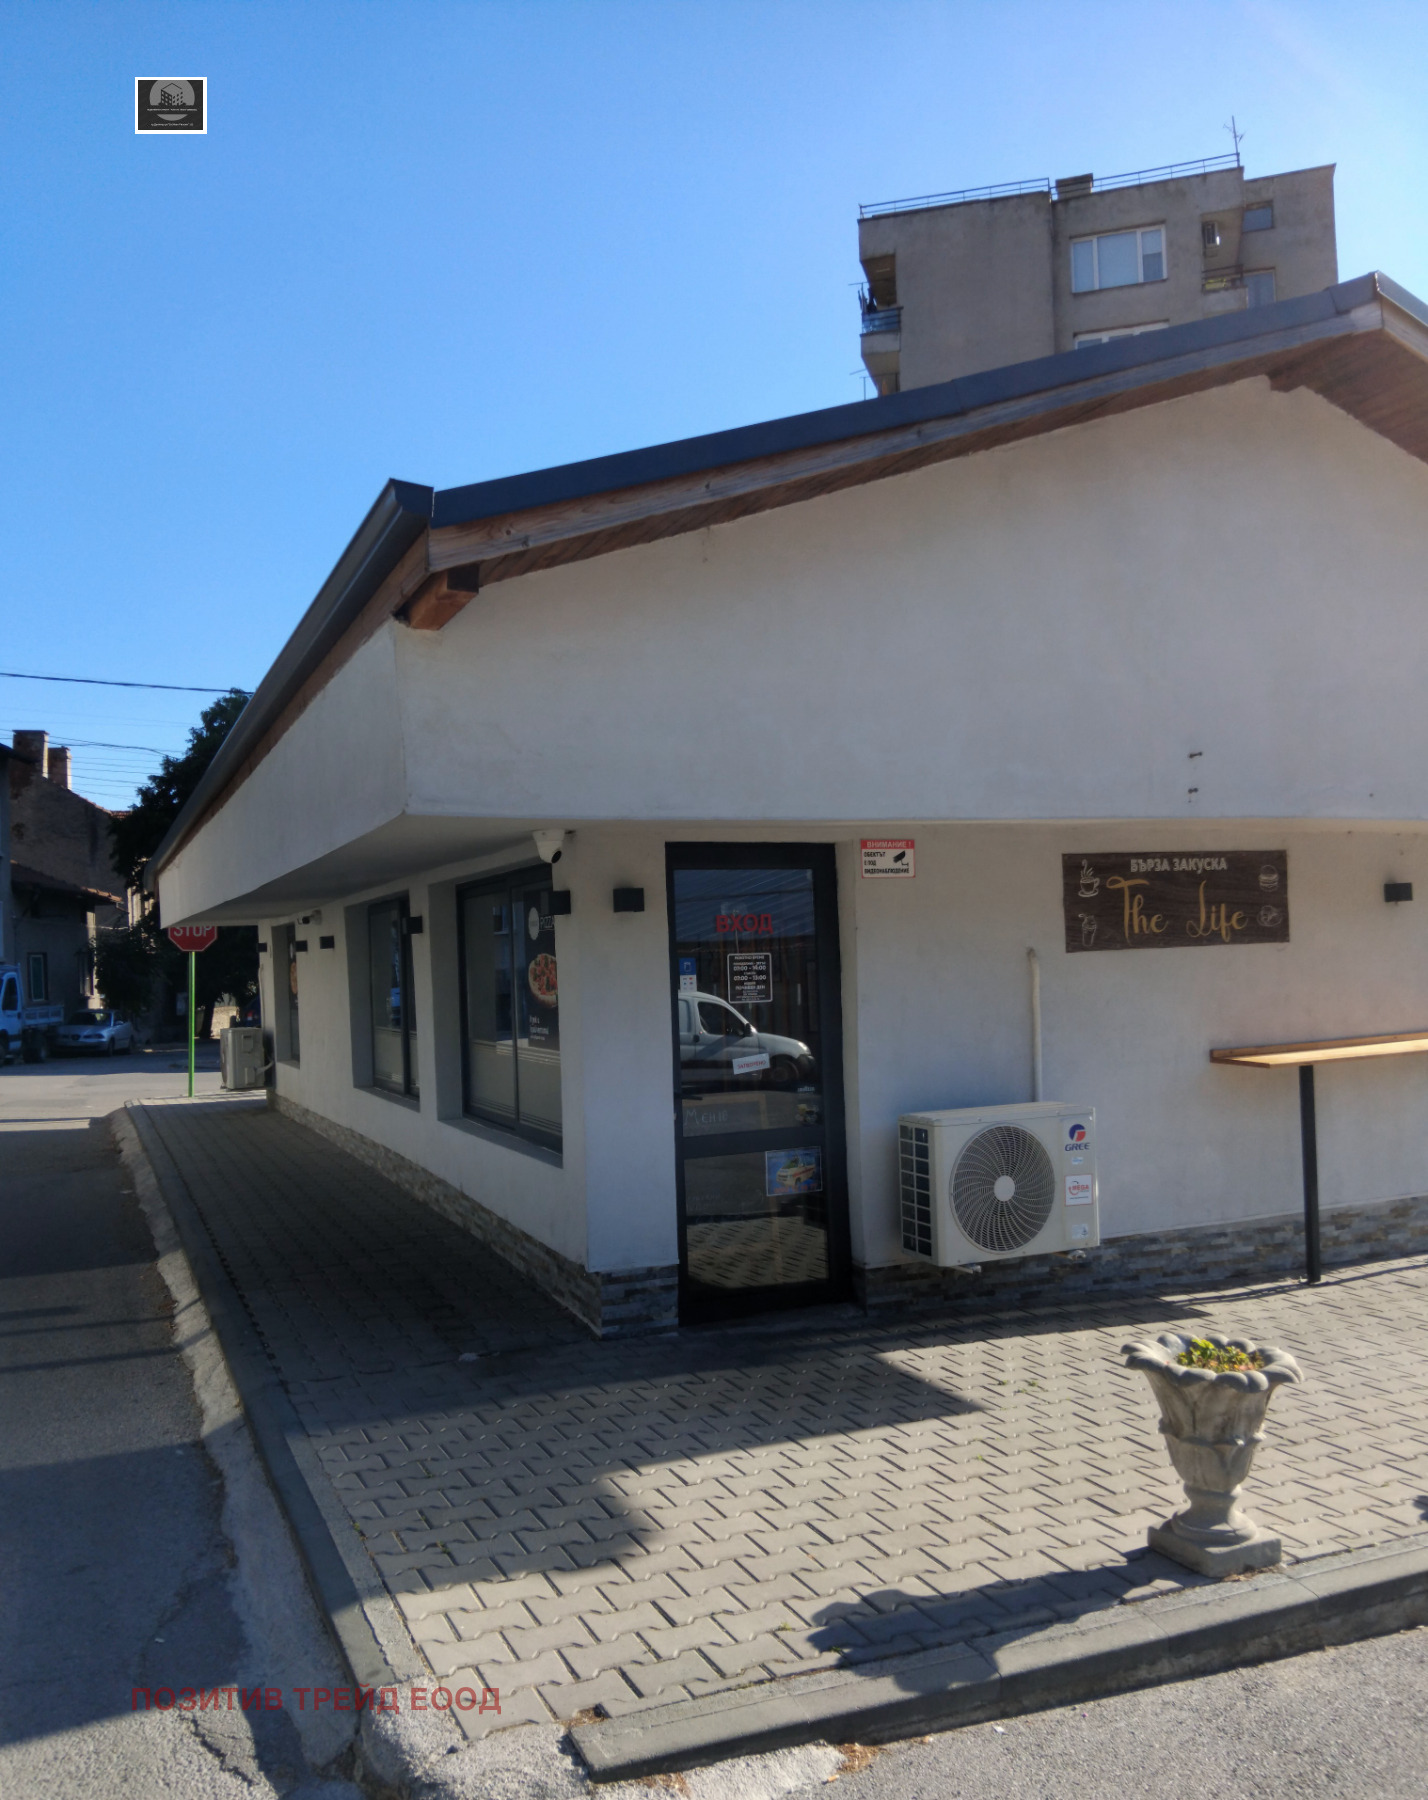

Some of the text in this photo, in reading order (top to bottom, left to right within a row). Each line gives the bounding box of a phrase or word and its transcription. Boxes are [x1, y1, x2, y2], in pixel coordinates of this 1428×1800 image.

[1130, 857, 1227, 874] БЪРЗА ЗАКУСКА
[1106, 876, 1248, 946] The Life
[173, 925, 212, 937] STOP
[715, 913, 774, 934] ВХОД
[1065, 1142, 1090, 1152] GREE
